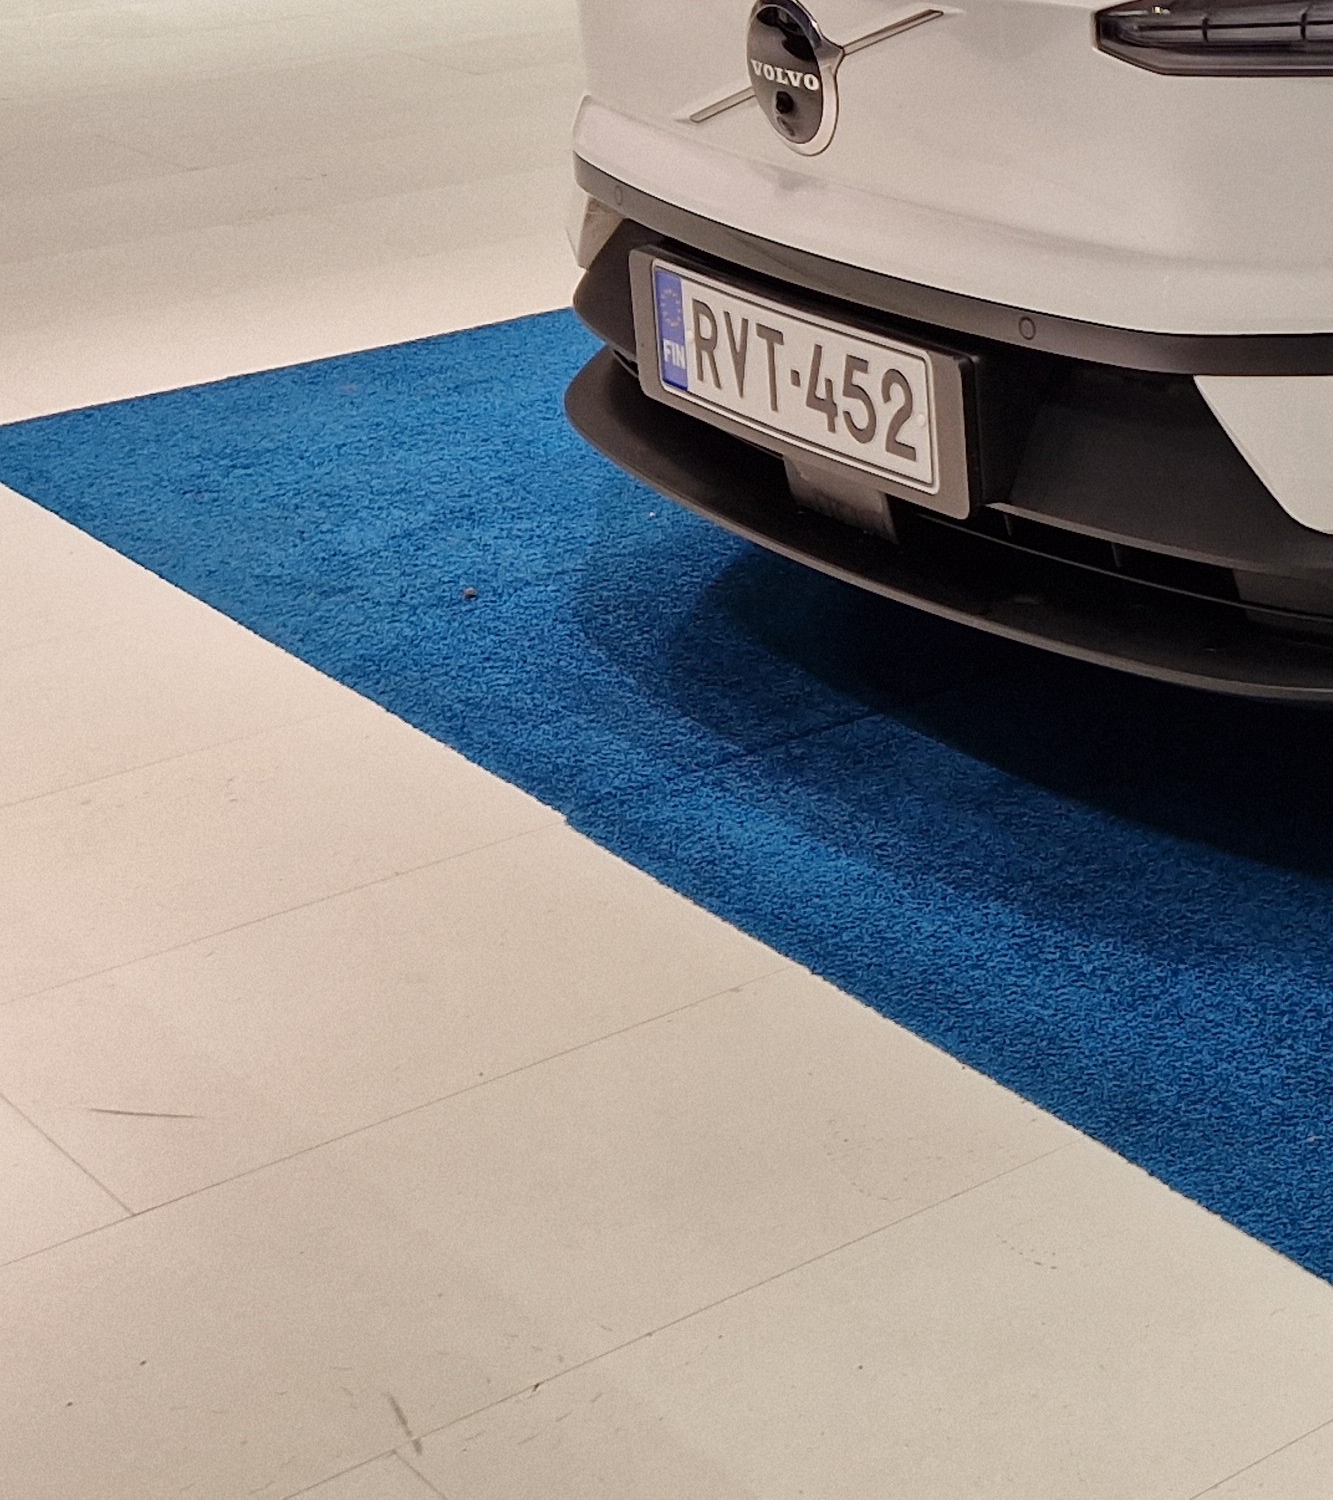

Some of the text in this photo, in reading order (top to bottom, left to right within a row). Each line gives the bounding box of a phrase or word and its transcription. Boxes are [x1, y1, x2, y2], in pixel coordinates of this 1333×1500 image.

[750, 58, 820, 92] VOLVO
[662, 338, 687, 370] FIN
[691, 297, 917, 462] RVT-452
